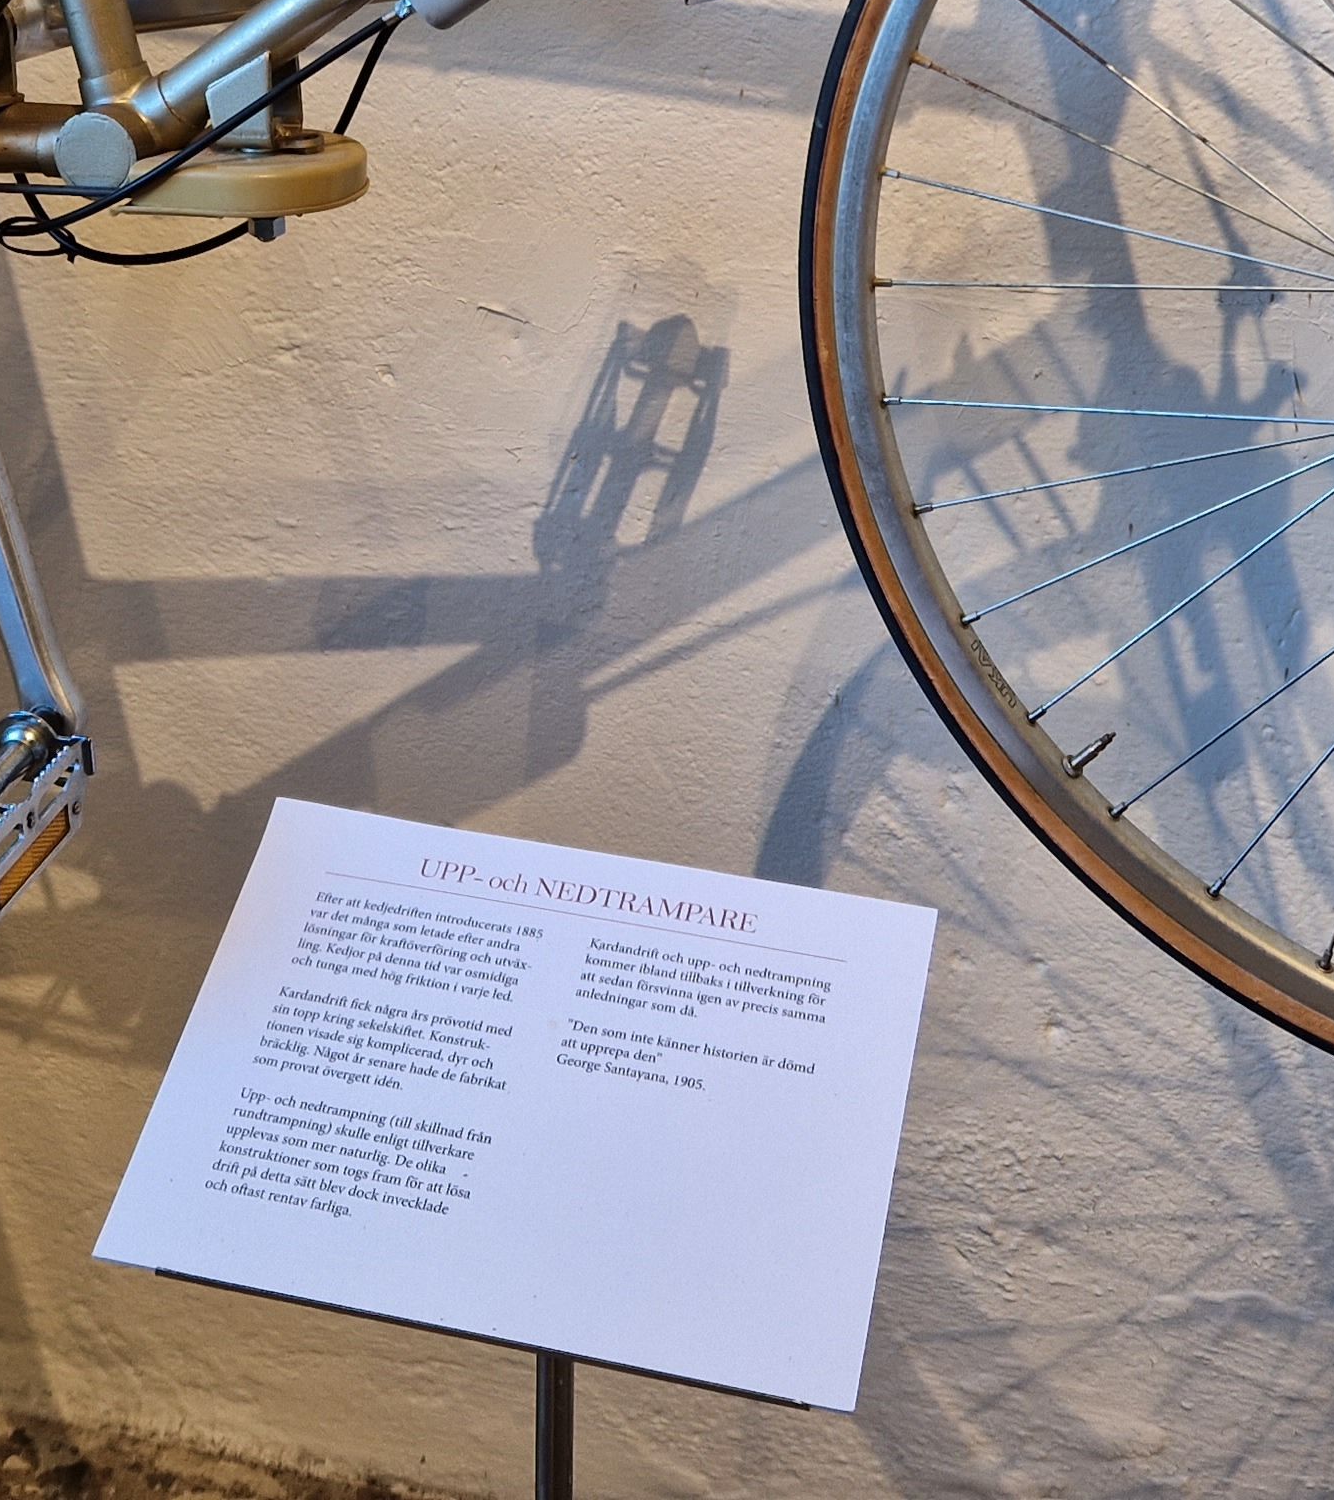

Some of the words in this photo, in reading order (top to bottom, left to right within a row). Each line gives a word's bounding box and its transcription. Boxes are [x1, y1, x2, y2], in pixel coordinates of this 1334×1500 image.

[315, 891, 345, 906] Efter
[345, 898, 362, 909] att
[362, 898, 433, 921] kedjedriften
[434, 911, 513, 934] introducerats
[515, 925, 544, 939] 1885
[420, 858, 484, 884] UPP-
[488, 873, 529, 895] och
[534, 876, 759, 934] NEDTRAMPARE
[303, 921, 359, 942] lösningar
[359, 931, 379, 945] för
[378, 933, 469, 963] kraftöverföring
[469, 951, 492, 965] och
[493, 956, 532, 971] utväx-
[310, 908, 330, 920] var
[330, 909, 350, 924] det
[351, 915, 391, 932] många
[392, 923, 418, 935] som
[419, 923, 456, 941] letade
[457, 931, 485, 946] efter
[485, 938, 521, 952] andra
[291, 954, 313, 968] och
[315, 958, 349, 976] tunga
[350, 966, 379, 979] med
[379, 967, 404, 986] hög
[404, 972, 451, 992] friktion
[452, 981, 459, 993] i
[461, 984, 491, 1000] varje
[491, 987, 513, 1003] led.
[296, 936, 323, 955] ling.
[325, 942, 367, 961] Kedjor
[366, 950, 383, 965] på
[384, 952, 422, 969] denna
[423, 959, 442, 973] tid
[443, 964, 464, 977] var
[464, 968, 519, 989] osmidiga
[556, 1053, 602, 1074] George
[603, 1060, 669, 1086] Santayana,
[673, 1075, 706, 1091] 1905.
[560, 1037, 579, 1050] att
[579, 1041, 630, 1061] upprepa
[600, 1027, 627, 1041] som
[629, 1030, 655, 1046] inte
[655, 1034, 701, 1054] känner
[702, 1042, 758, 1065] historien
[761, 1055, 776, 1068] är
[777, 1057, 816, 1075] dömd
[232, 1107, 333, 1137] rundtrampning)
[333, 1123, 372, 1141] skulle
[372, 1132, 410, 1152] enligt
[411, 1138, 475, 1161] tillverkare
[240, 1086, 271, 1106] Upp-
[273, 1094, 297, 1109] och
[298, 1100, 388, 1129] nedtrampning
[388, 1114, 413, 1130] (till
[413, 1119, 465, 1140] skillnad
[465, 1128, 492, 1145] från
[218, 1139, 313, 1169] konstruktioner
[312, 1161, 340, 1175] som
[342, 1164, 370, 1183] togs
[370, 1168, 402, 1187] fram
[404, 1174, 425, 1191] för
[425, 1182, 445, 1195] att
[444, 1182, 471, 1200] lösa
[226, 1125, 280, 1143] upplevas
[281, 1135, 309, 1149] som
[310, 1141, 338, 1154] mer
[338, 1146, 391, 1168] naturlig.
[394, 1153, 414, 1169] De
[415, 1157, 447, 1175] olika
[204, 1178, 228, 1193] och
[230, 1182, 266, 1200] oftast
[267, 1191, 309, 1208] rentav
[309, 1196, 352, 1219] farliga.
[211, 1157, 240, 1176] drift
[239, 1165, 258, 1181] på
[259, 1167, 292, 1185] detta
[293, 1175, 318, 1191] sätt
[318, 1177, 347, 1195] blev
[347, 1184, 380, 1202] dock
[381, 1191, 450, 1216] invecklade
